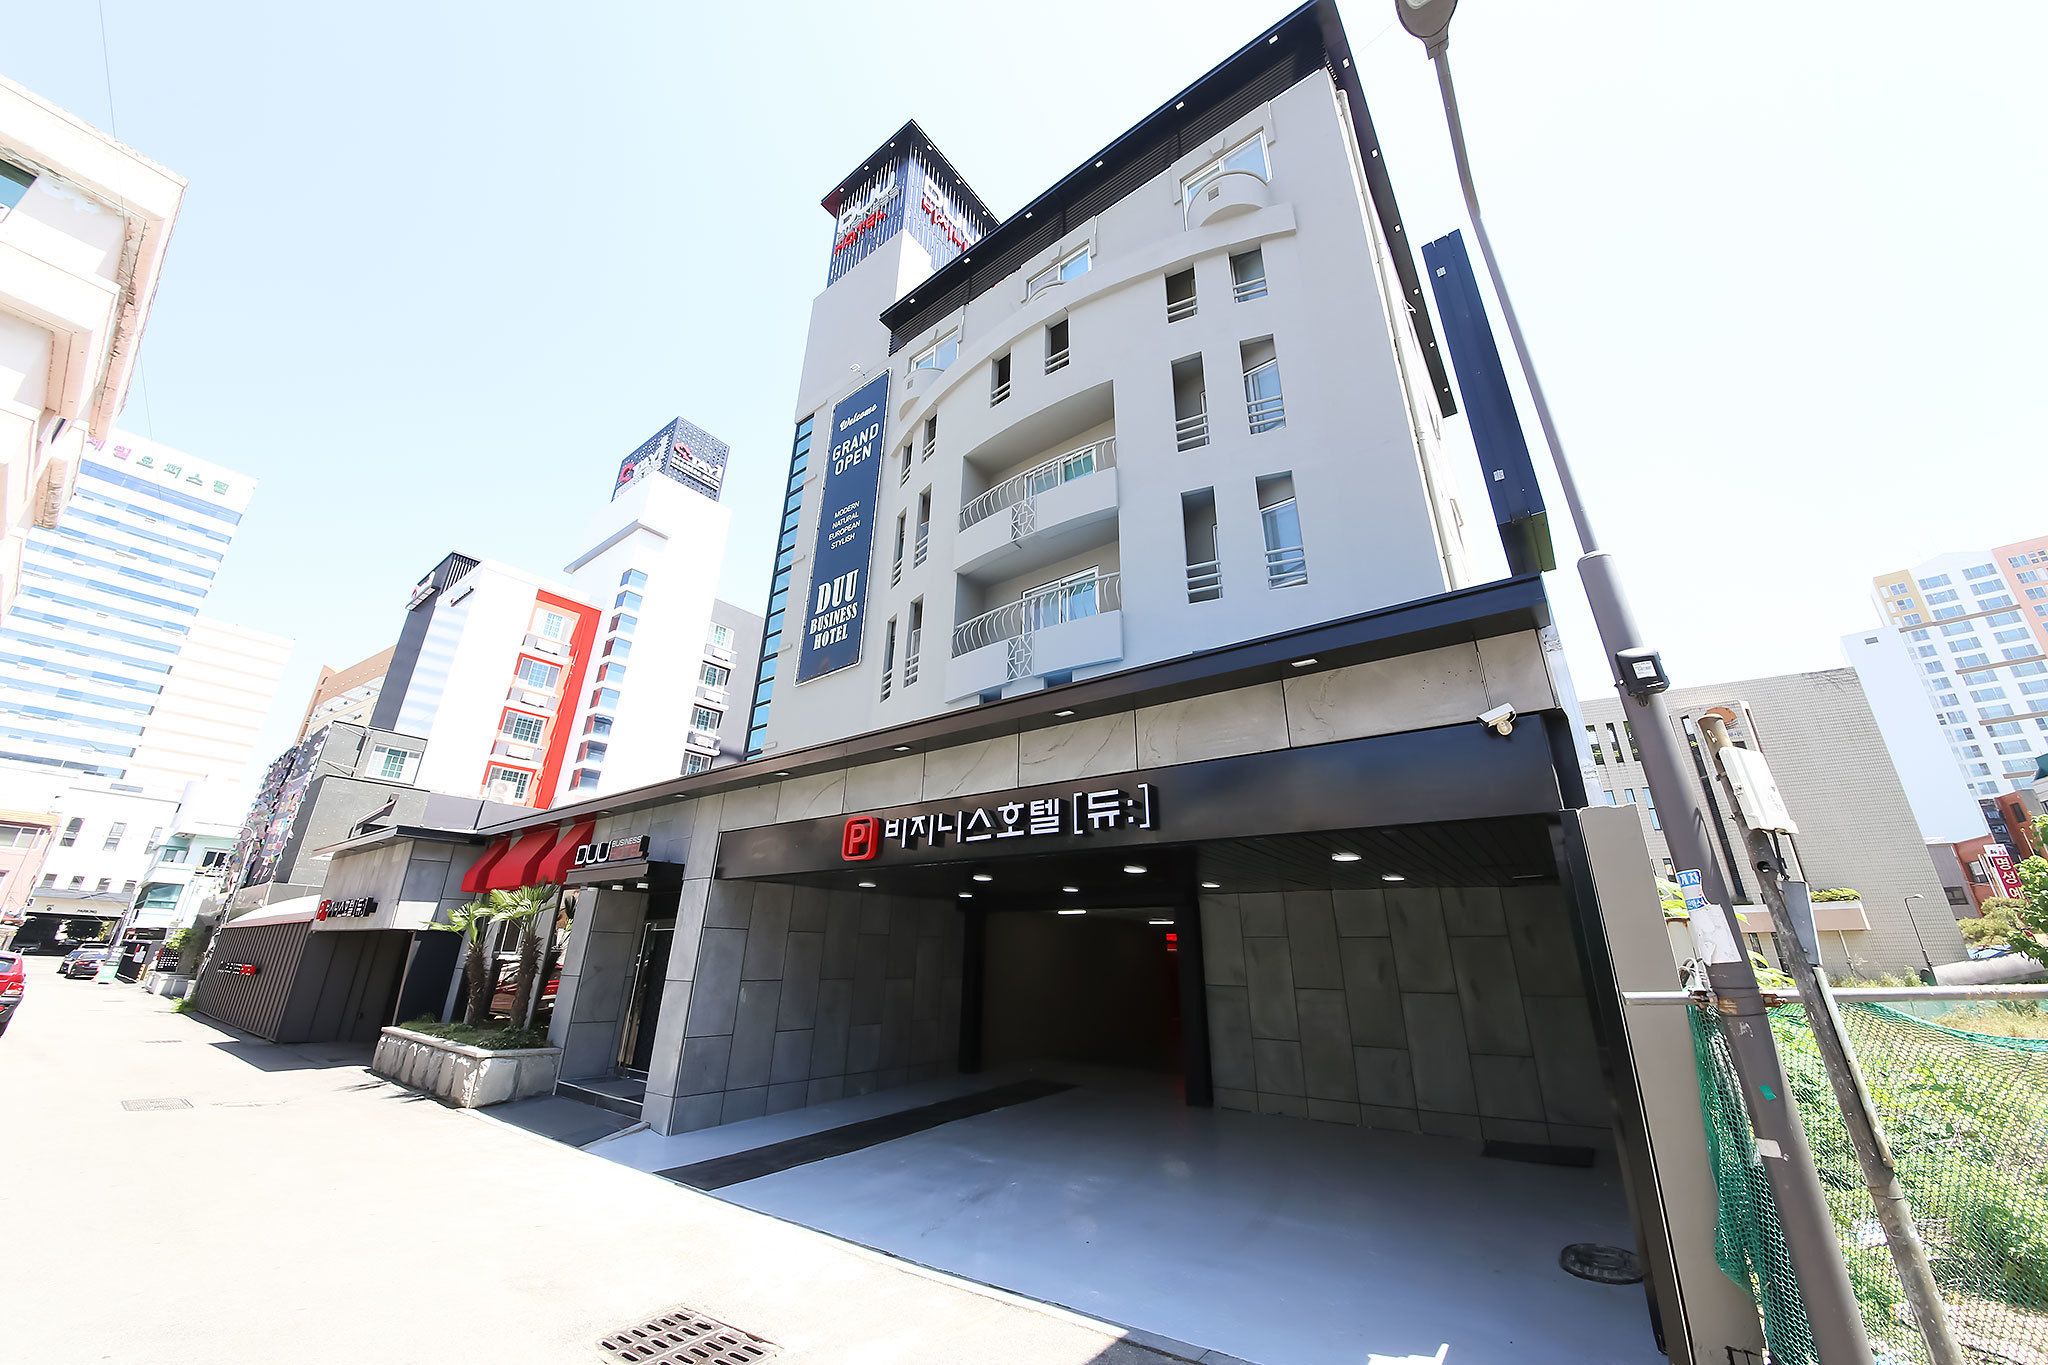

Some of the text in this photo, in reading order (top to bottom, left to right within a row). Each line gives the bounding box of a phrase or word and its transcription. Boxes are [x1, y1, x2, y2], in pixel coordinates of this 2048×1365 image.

[839, 403, 878, 431] Welcome
[832, 422, 879, 461] GRAND
[834, 441, 873, 476] OPEN
[832, 511, 859, 529] NATURAL
[834, 500, 860, 519] MODERN
[829, 519, 861, 541] EUROPEAN
[830, 532, 856, 550] STYLISH
[815, 568, 859, 615] DUU
[809, 601, 858, 635] BUSINESS
[813, 623, 849, 651] HOTEL
[884, 798, 1060, 849] 비지니스호텔
[575, 835, 643, 865] DUU BUSINESS
